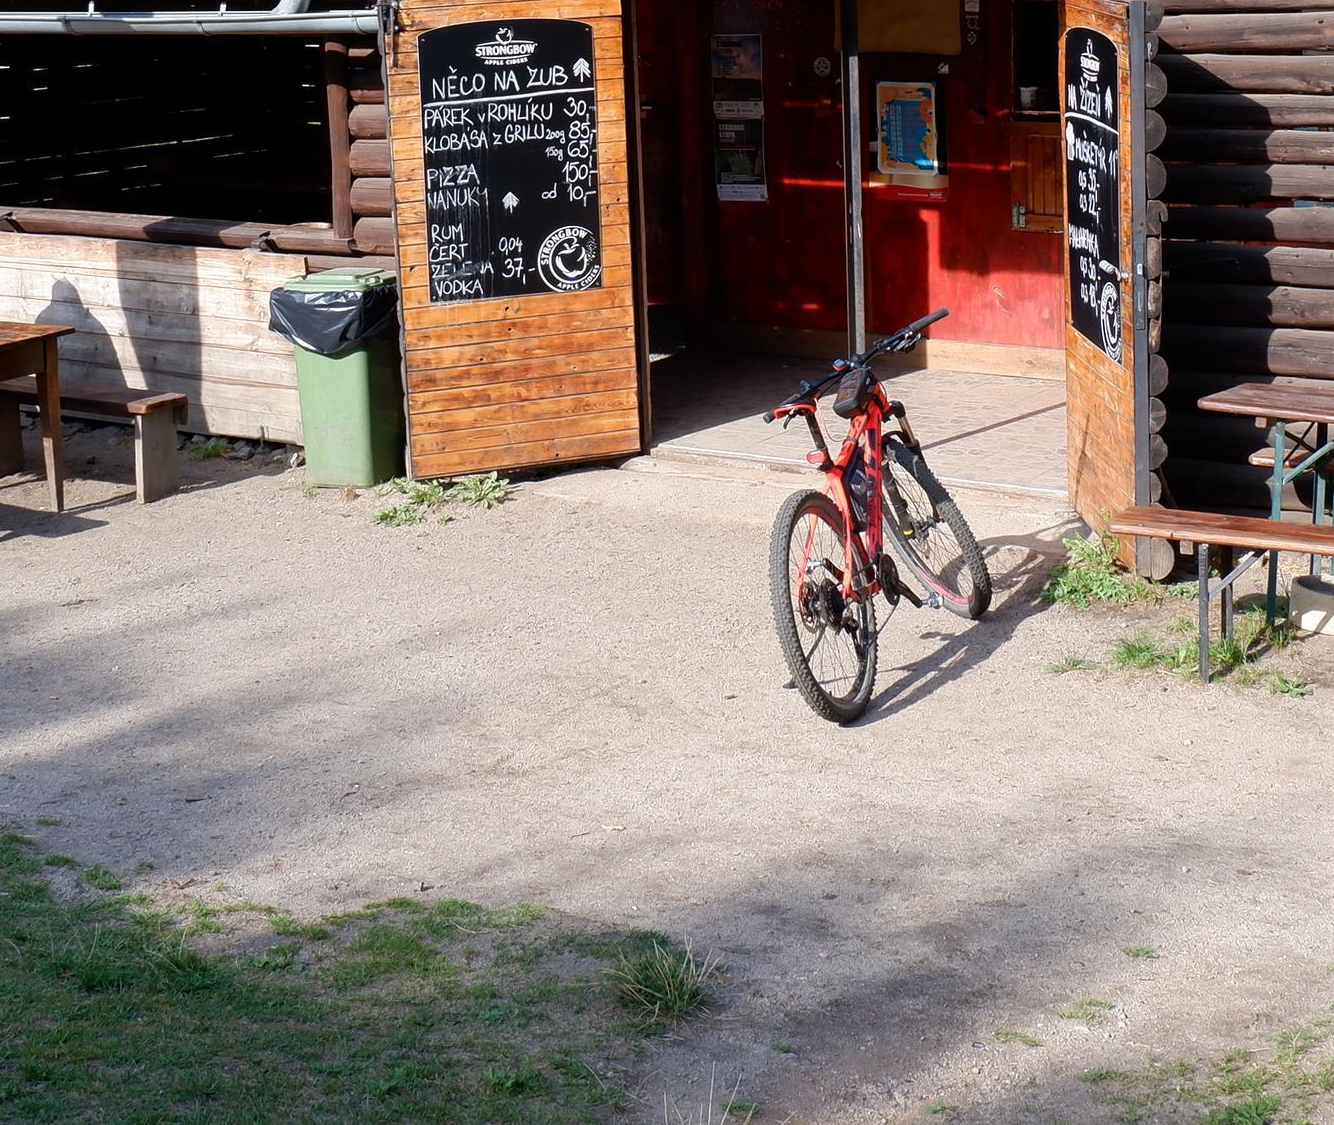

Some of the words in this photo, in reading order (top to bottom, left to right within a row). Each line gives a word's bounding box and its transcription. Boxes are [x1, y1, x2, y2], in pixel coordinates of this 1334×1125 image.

[475, 43, 535, 57] STRONGBOW
[505, 57, 528, 65] CIDERS
[432, 66, 486, 100] NĚCO
[494, 70, 520, 91] NA
[526, 65, 569, 88] ZUB
[424, 106, 474, 129] PÁREK
[488, 98, 553, 122] ROHLÍKU
[424, 126, 489, 154] KLOBÁSA
[504, 124, 545, 144] GRILU
[545, 129, 565, 144] 200g
[545, 146, 564, 161] 150g
[426, 163, 480, 189] PIZZA
[427, 186, 489, 211] NANUKY
[541, 182, 557, 200] od
[431, 223, 464, 243] RUM
[429, 243, 469, 262] ČERT
[540, 228, 588, 266] STRONGBOW
[434, 279, 484, 297] VODKA
[557, 282, 579, 290] APPLE
[580, 264, 600, 287] CIDERS
